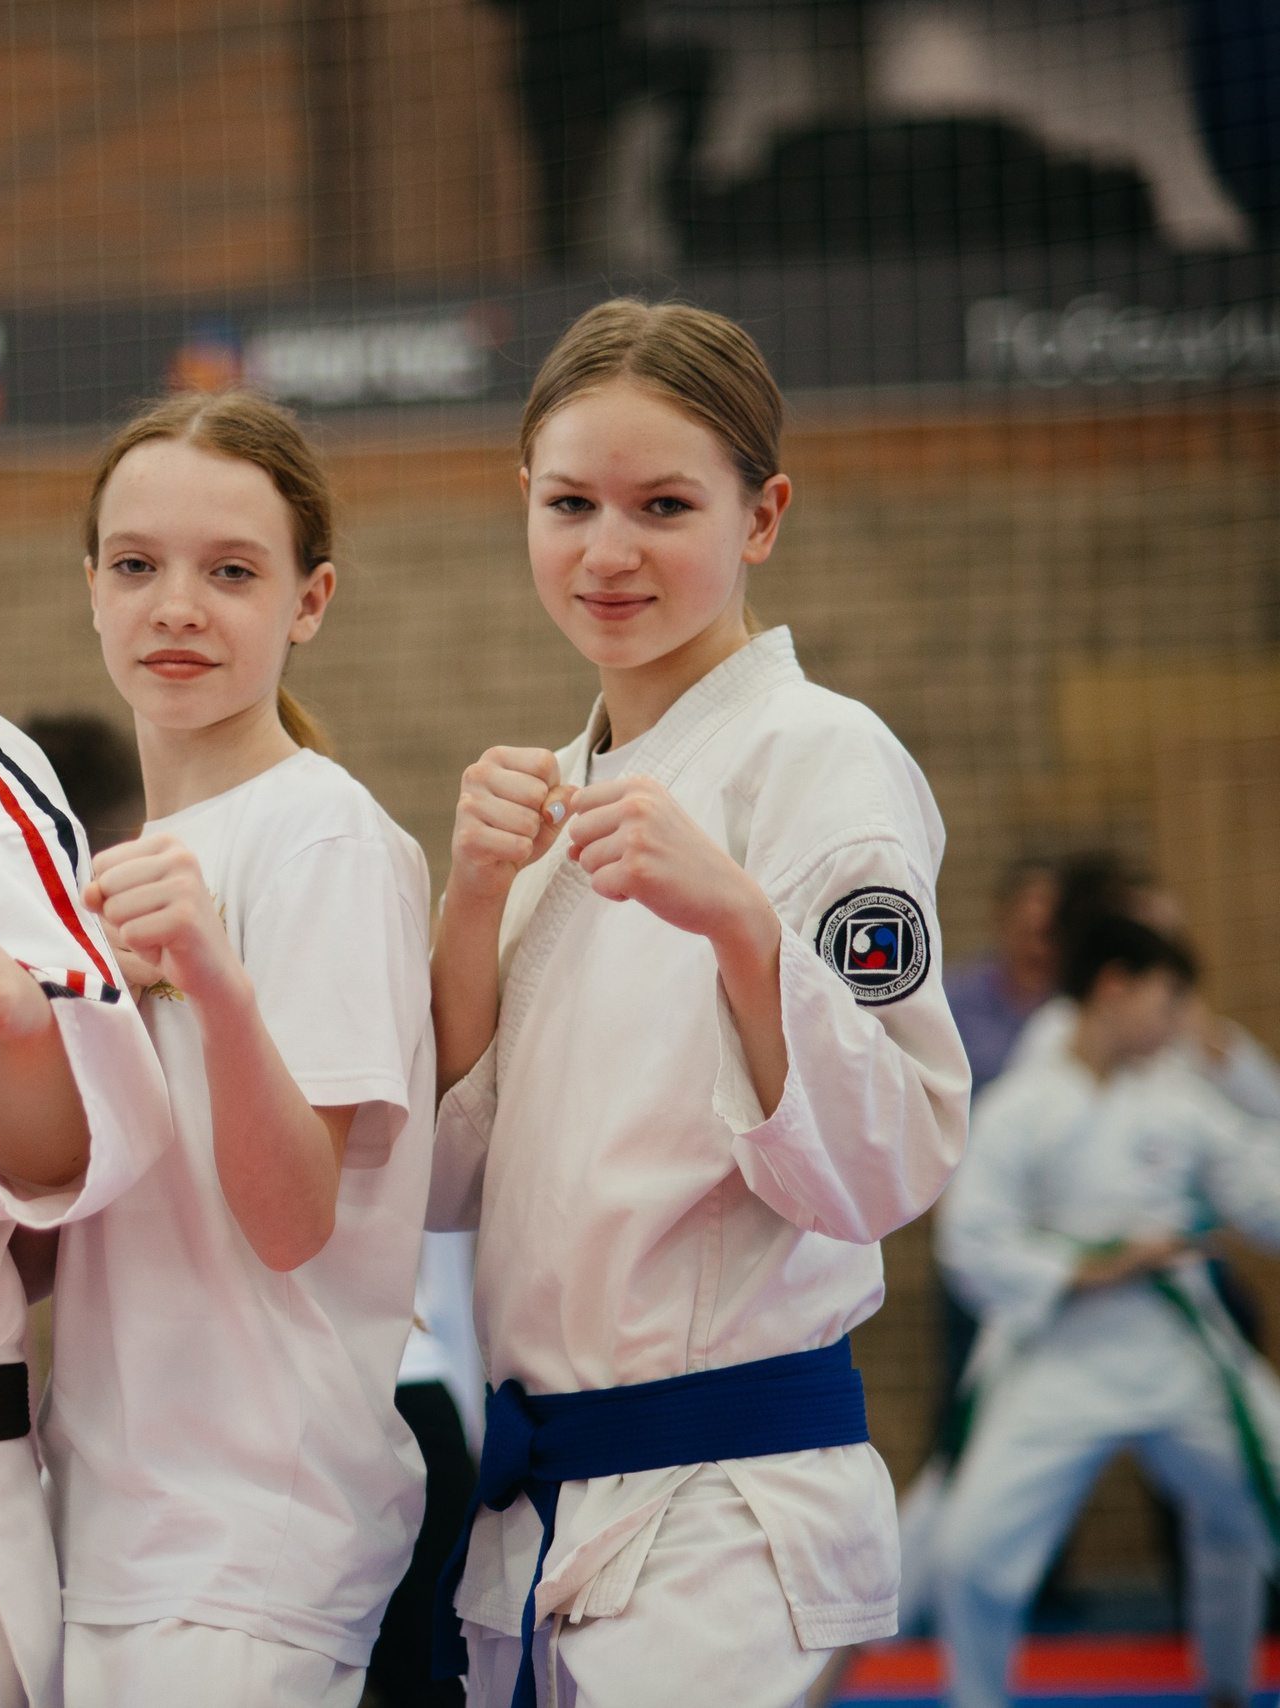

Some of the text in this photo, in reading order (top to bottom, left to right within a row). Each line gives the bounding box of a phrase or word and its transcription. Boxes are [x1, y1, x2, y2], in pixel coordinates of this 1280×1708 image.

[878, 896, 908, 912] КОБУДО
[889, 967, 918, 993] Kobudo
[913, 921, 923, 967] Federation
